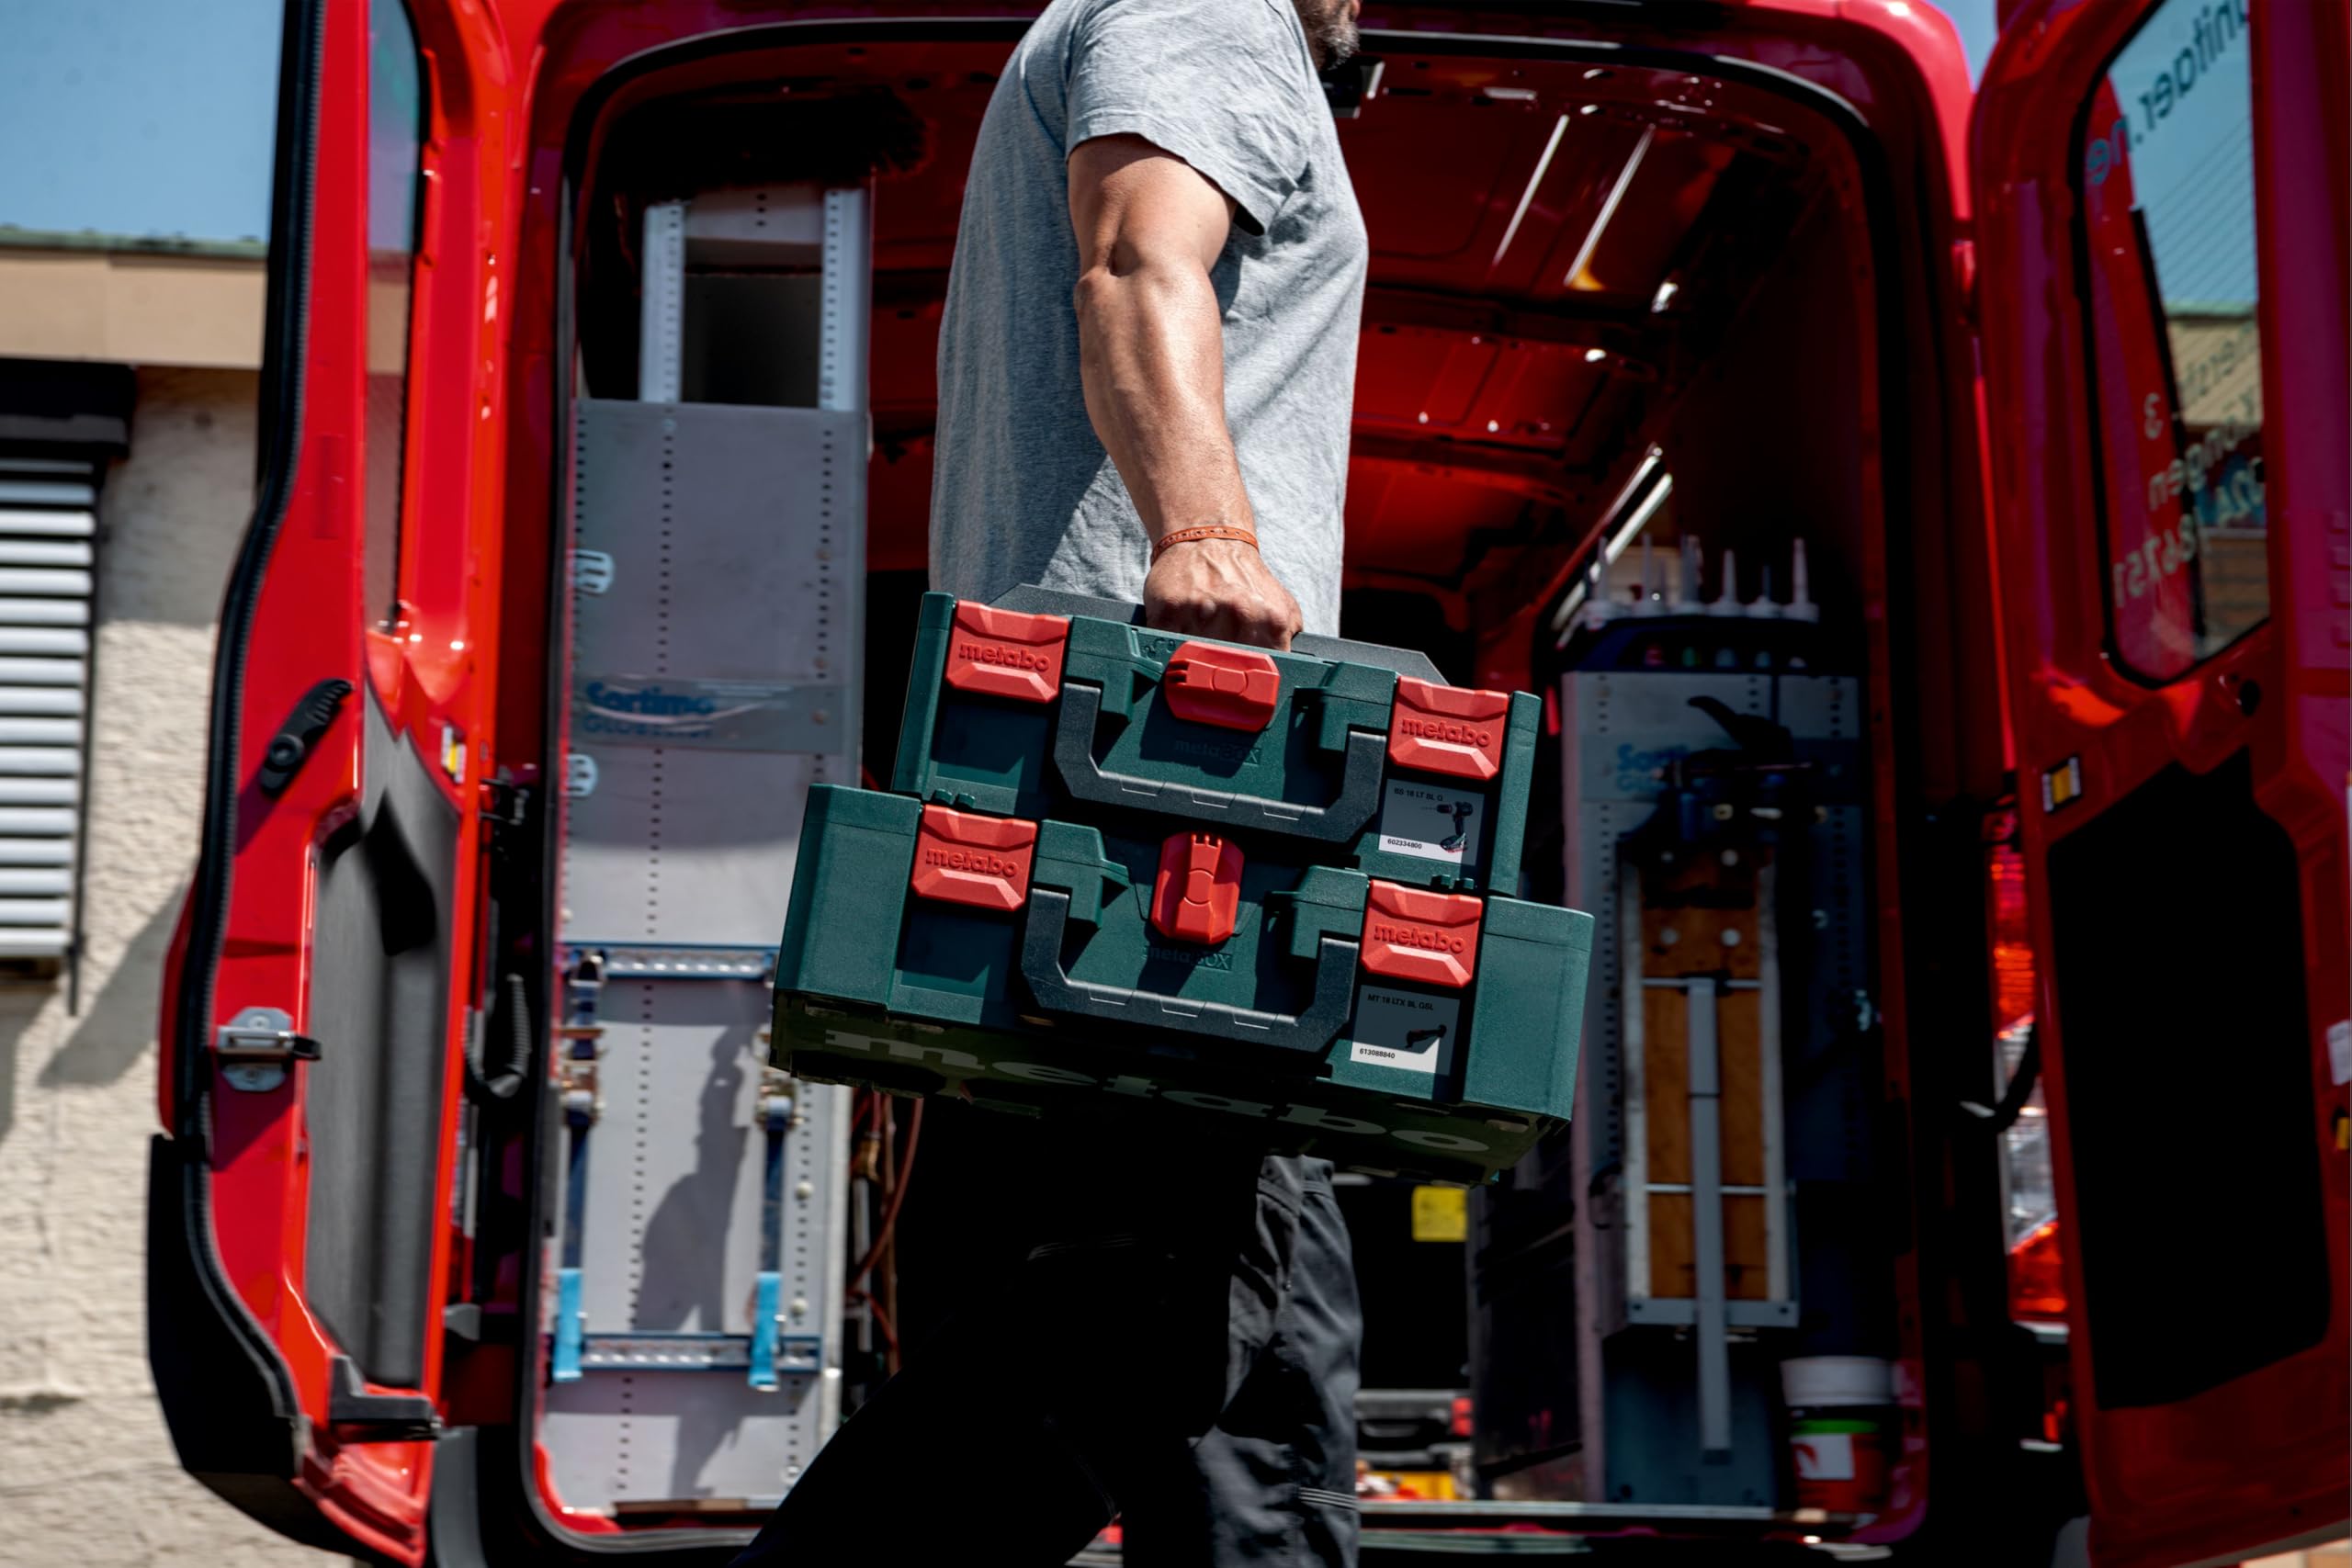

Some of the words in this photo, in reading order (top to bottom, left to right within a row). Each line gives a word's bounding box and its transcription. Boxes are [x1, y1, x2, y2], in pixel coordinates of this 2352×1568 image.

[959, 642, 1049, 672] metabo
[1401, 717, 1491, 749] metabo
[1387, 838, 1422, 850] 602334800
[926, 846, 1020, 877] metabo
[1374, 923, 1465, 953] metabo
[1366, 993, 1380, 1002] MT
[1392, 997, 1406, 1007] LTX
[1360, 1048, 1396, 1059] 613088840
[825, 1029, 1491, 1153] metabo
